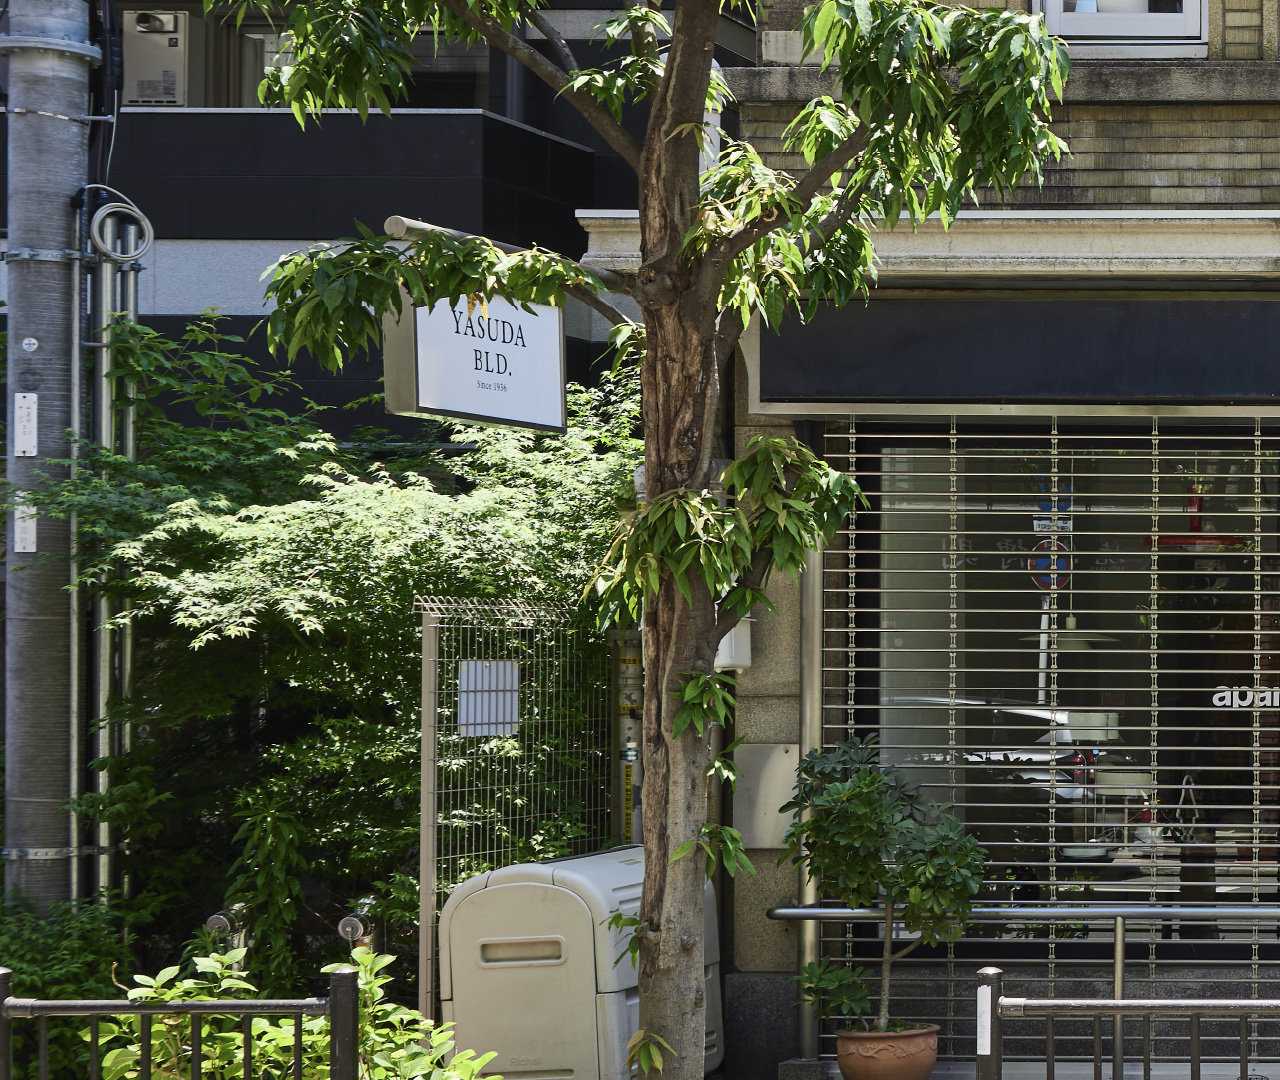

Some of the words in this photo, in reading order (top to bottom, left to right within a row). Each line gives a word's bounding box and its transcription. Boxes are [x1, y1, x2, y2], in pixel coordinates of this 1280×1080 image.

[452, 309, 527, 349] YASUDA
[474, 349, 513, 377] BLD.
[476, 379, 492, 391] Since
[493, 382, 508, 393] 1936
